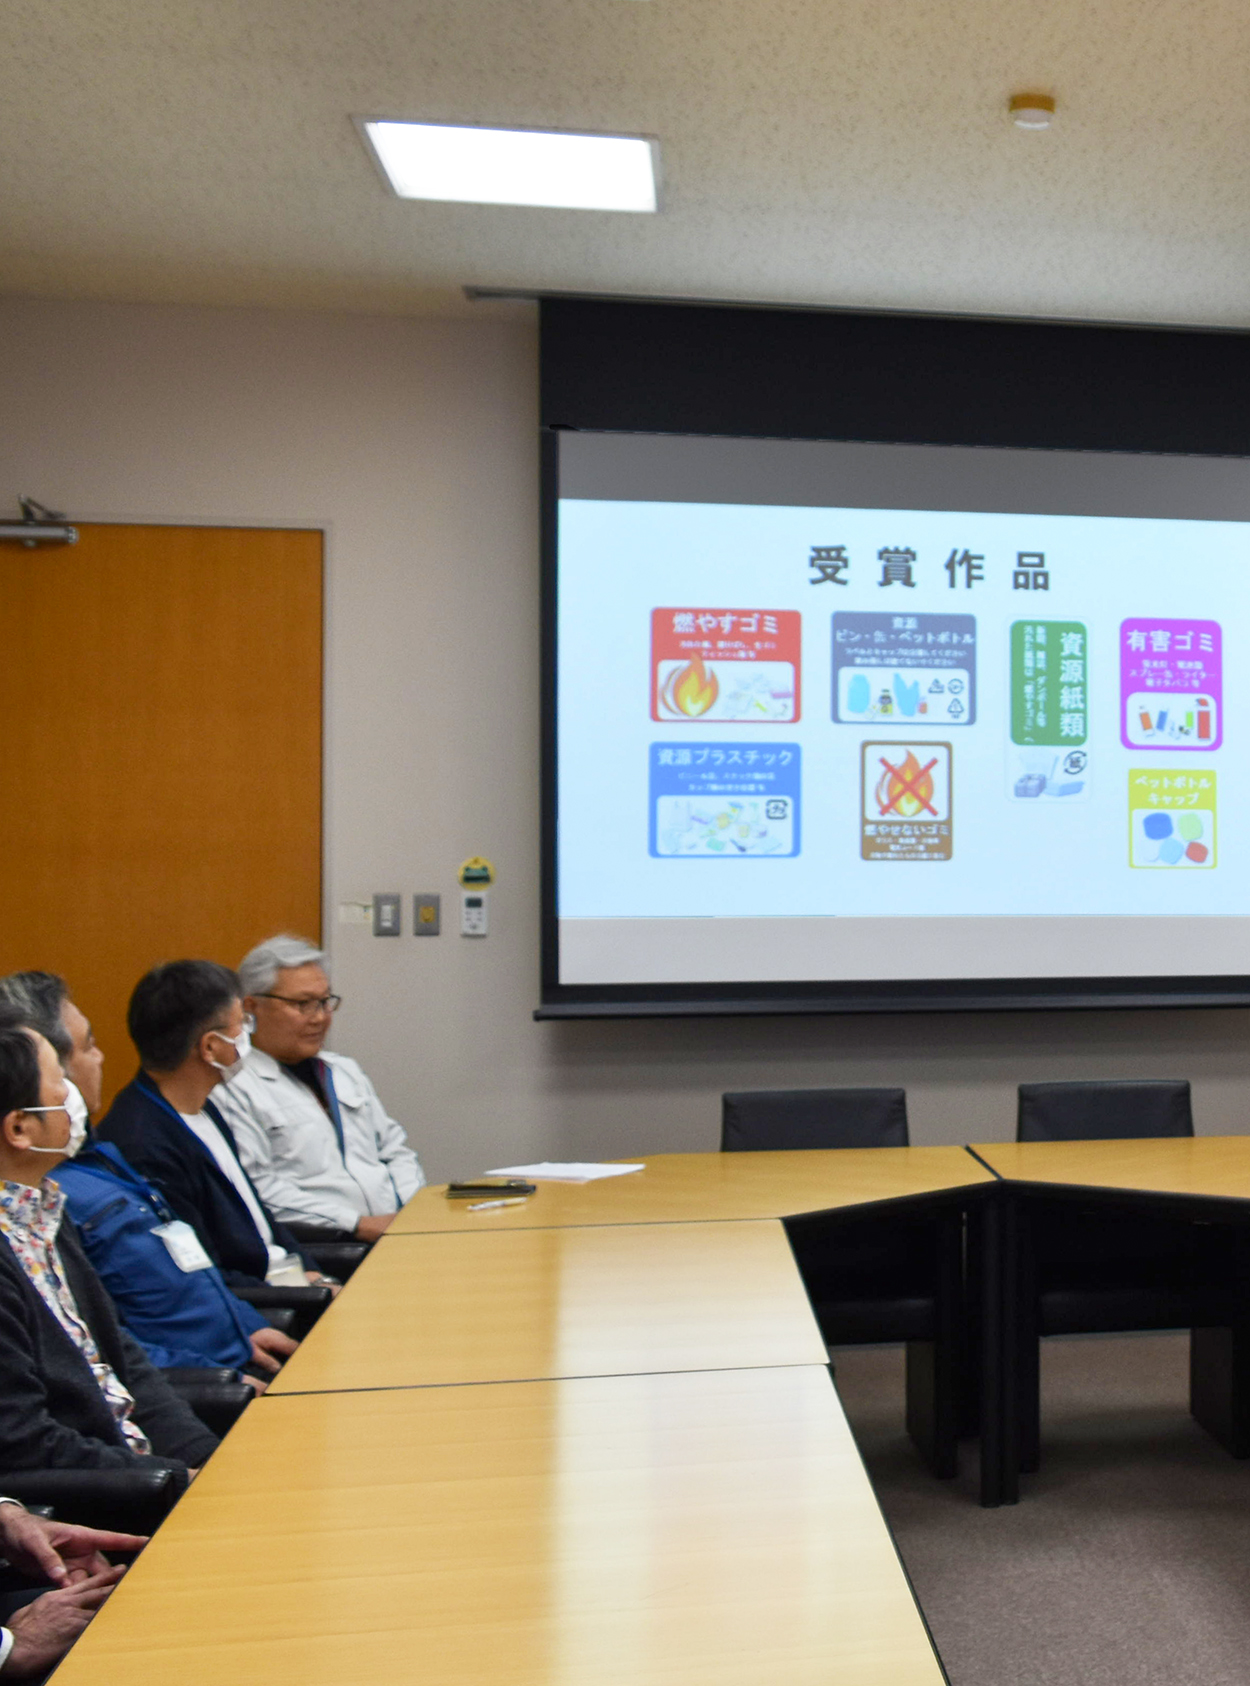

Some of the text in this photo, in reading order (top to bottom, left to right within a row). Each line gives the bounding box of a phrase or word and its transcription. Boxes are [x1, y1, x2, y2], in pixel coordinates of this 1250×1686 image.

[809, 545, 1049, 590] 受賞作品
[672, 612, 778, 635] 燃やすゴミ
[1126, 629, 1214, 652] 有害ゴミ
[1060, 631, 1085, 738] 資源紙類
[656, 748, 794, 767] 資源プラスチック
[1134, 775, 1212, 789] ペットボトル
[1147, 792, 1200, 806] キャップ
